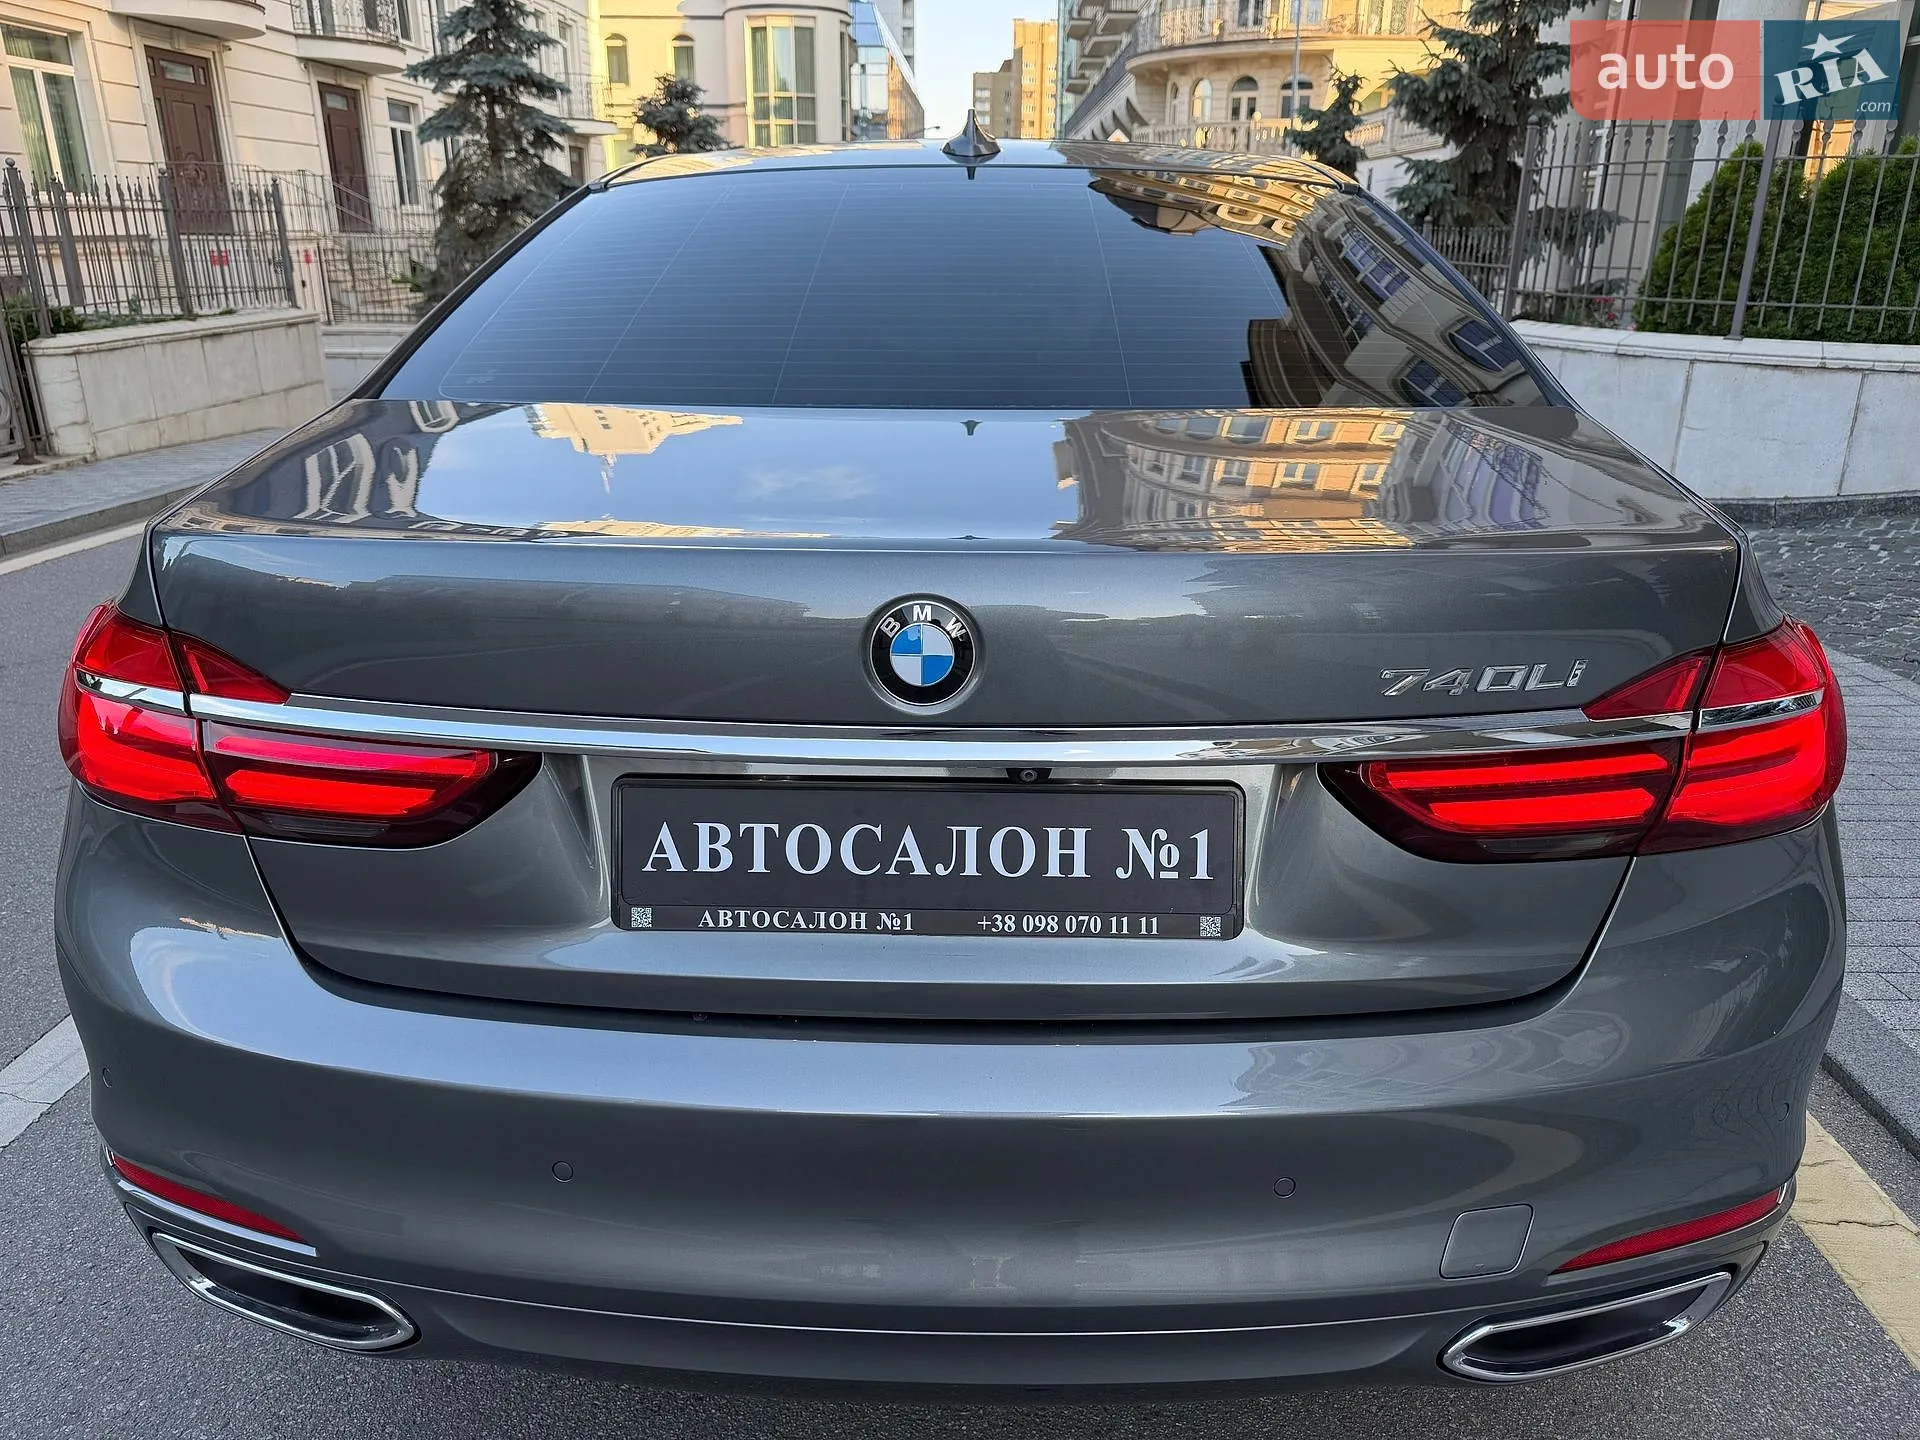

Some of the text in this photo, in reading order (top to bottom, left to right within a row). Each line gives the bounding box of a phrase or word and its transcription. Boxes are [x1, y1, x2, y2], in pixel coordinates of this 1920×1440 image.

[880, 604, 967, 642] BMW
[641, 821, 1214, 880] АВТОСАЛОН №1
[698, 909, 914, 931] АВТОСАЛОН №1
[977, 914, 1159, 935] +38 098 070 11 11
